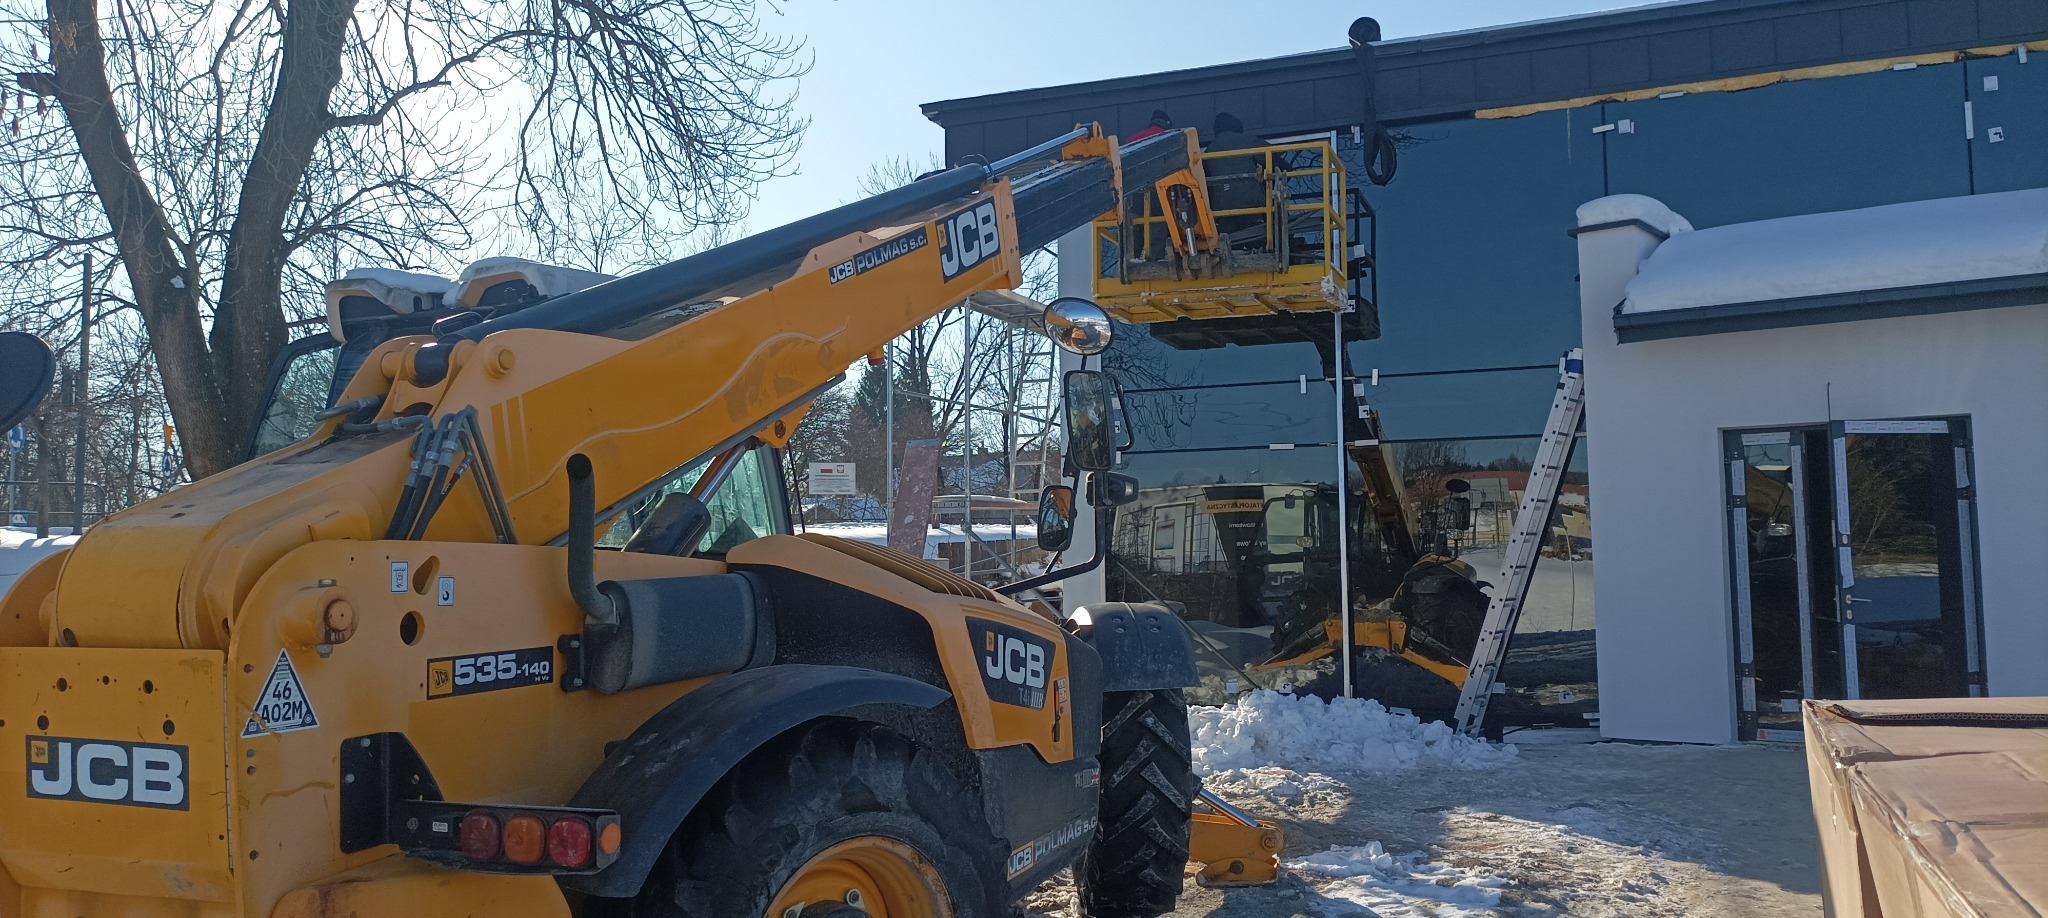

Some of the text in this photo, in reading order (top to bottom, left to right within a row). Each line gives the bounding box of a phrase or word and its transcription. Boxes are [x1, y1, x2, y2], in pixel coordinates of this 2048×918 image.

[830, 260, 854, 284] JCB
[855, 238, 909, 273] POLMAG
[910, 235, 927, 250] s.c.
[941, 202, 999, 277] JCB
[986, 634, 1045, 689] JCB
[272, 680, 292, 701] 46
[32, 741, 185, 805] JCB
[1009, 846, 1032, 875] JCB
[1034, 819, 1082, 862] POLMAG
